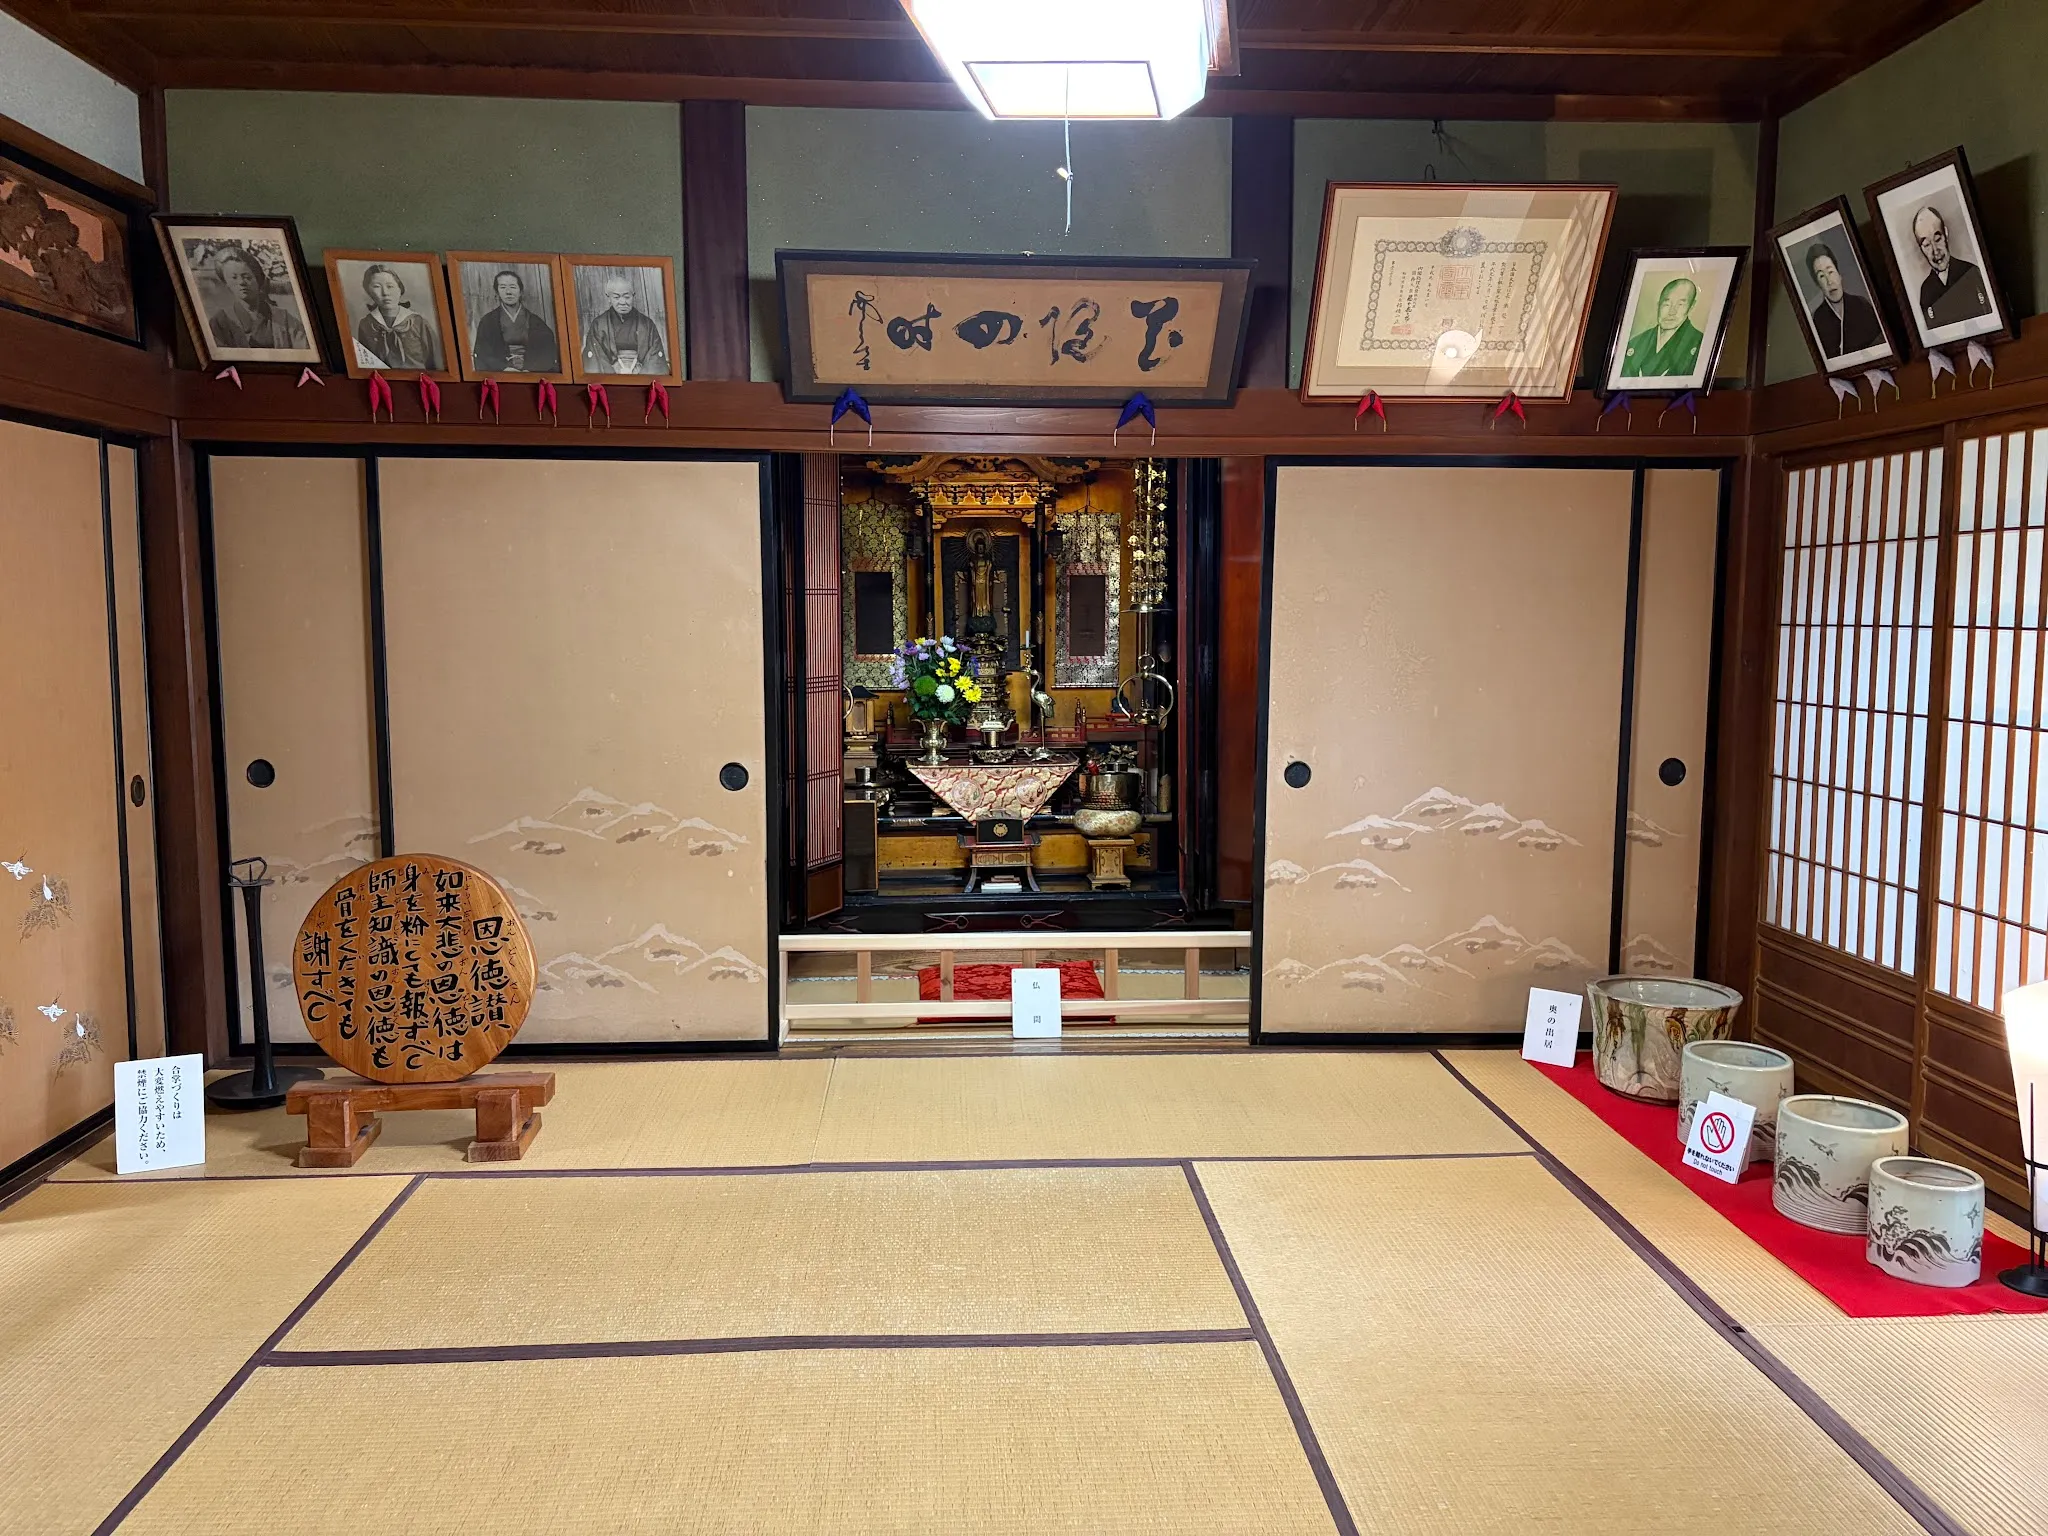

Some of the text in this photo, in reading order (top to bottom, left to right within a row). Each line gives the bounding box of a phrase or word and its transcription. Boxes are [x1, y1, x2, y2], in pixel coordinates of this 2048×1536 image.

[302, 930, 336, 1022] 謝すべし
[334, 887, 364, 1040] 骨をくだきても
[365, 869, 400, 1068] 師主知識の恩徳も
[398, 862, 436, 1069] 身を粉にしても報ずべし
[428, 869, 468, 1062] 如来大悲の恩徳は
[469, 916, 511, 1032] 恩徳讃
[1543, 1004, 1558, 1049] 奥の出居
[137, 1069, 149, 1165] 禁煙にご協力ください。
[154, 1067, 166, 1152] 大変燃えやすいため、
[171, 1065, 182, 1120] 合掌づくりは
[1687, 1147, 1735, 1172] 手を触れないでください
[1693, 1158, 1723, 1176] Do not touch
